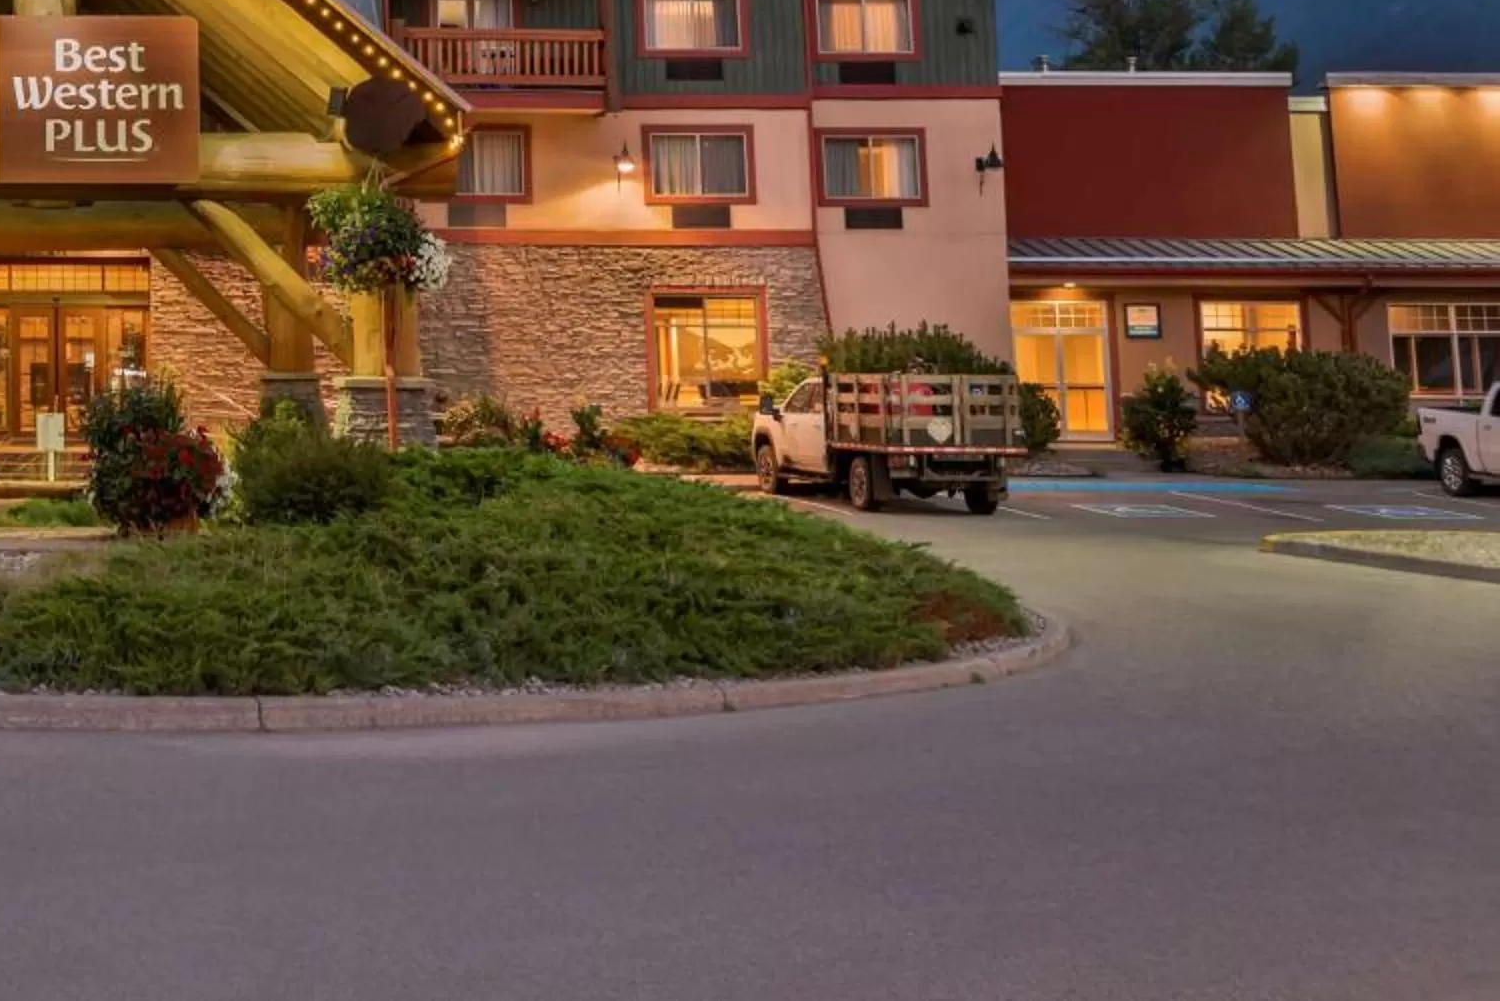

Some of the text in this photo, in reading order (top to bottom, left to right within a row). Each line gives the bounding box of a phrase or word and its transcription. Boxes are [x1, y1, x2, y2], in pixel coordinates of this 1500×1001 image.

[54, 38, 146, 73] Best
[12, 75, 185, 111] Western
[45, 118, 153, 153] PLUS
